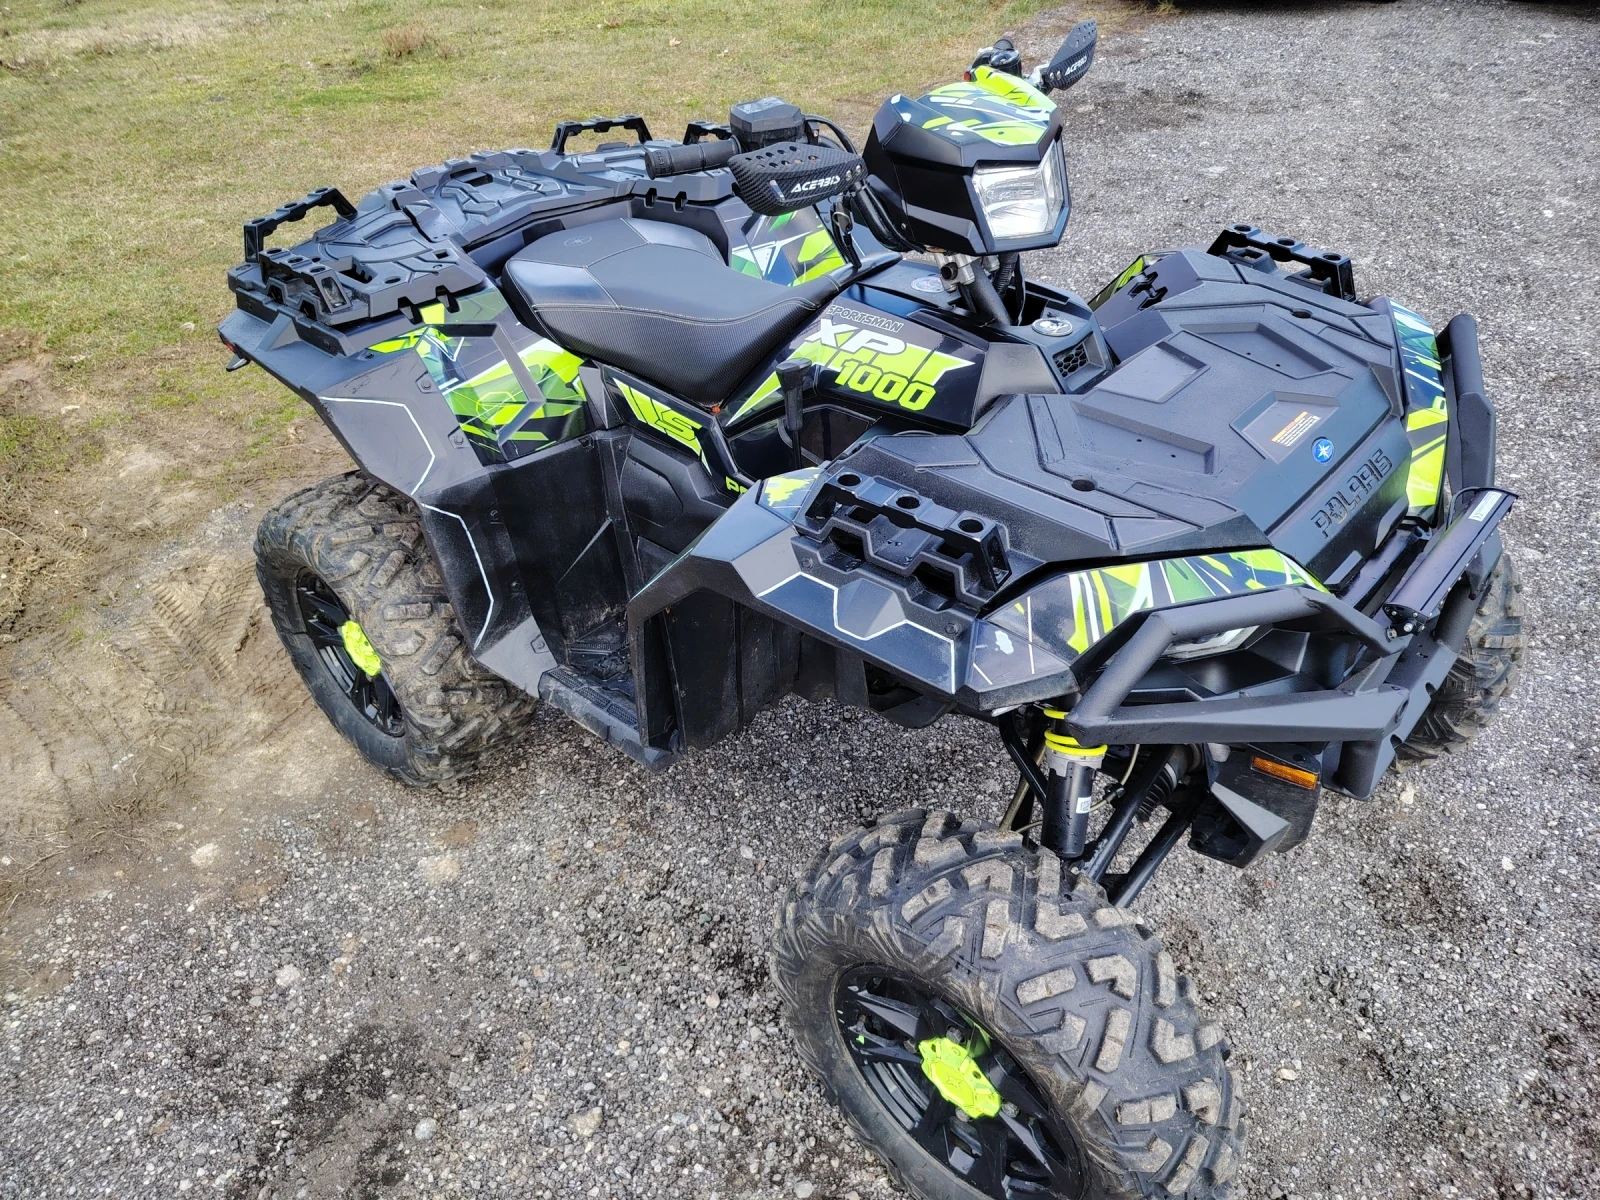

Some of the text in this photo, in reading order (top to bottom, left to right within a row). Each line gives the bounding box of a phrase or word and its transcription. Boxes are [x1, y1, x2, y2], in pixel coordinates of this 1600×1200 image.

[790, 175, 841, 193] ACERBIS
[805, 317, 907, 355] XP
[826, 304, 904, 334] SPORTSMAN
[833, 359, 937, 411] 1000
[1310, 448, 1393, 540] POLARIS
